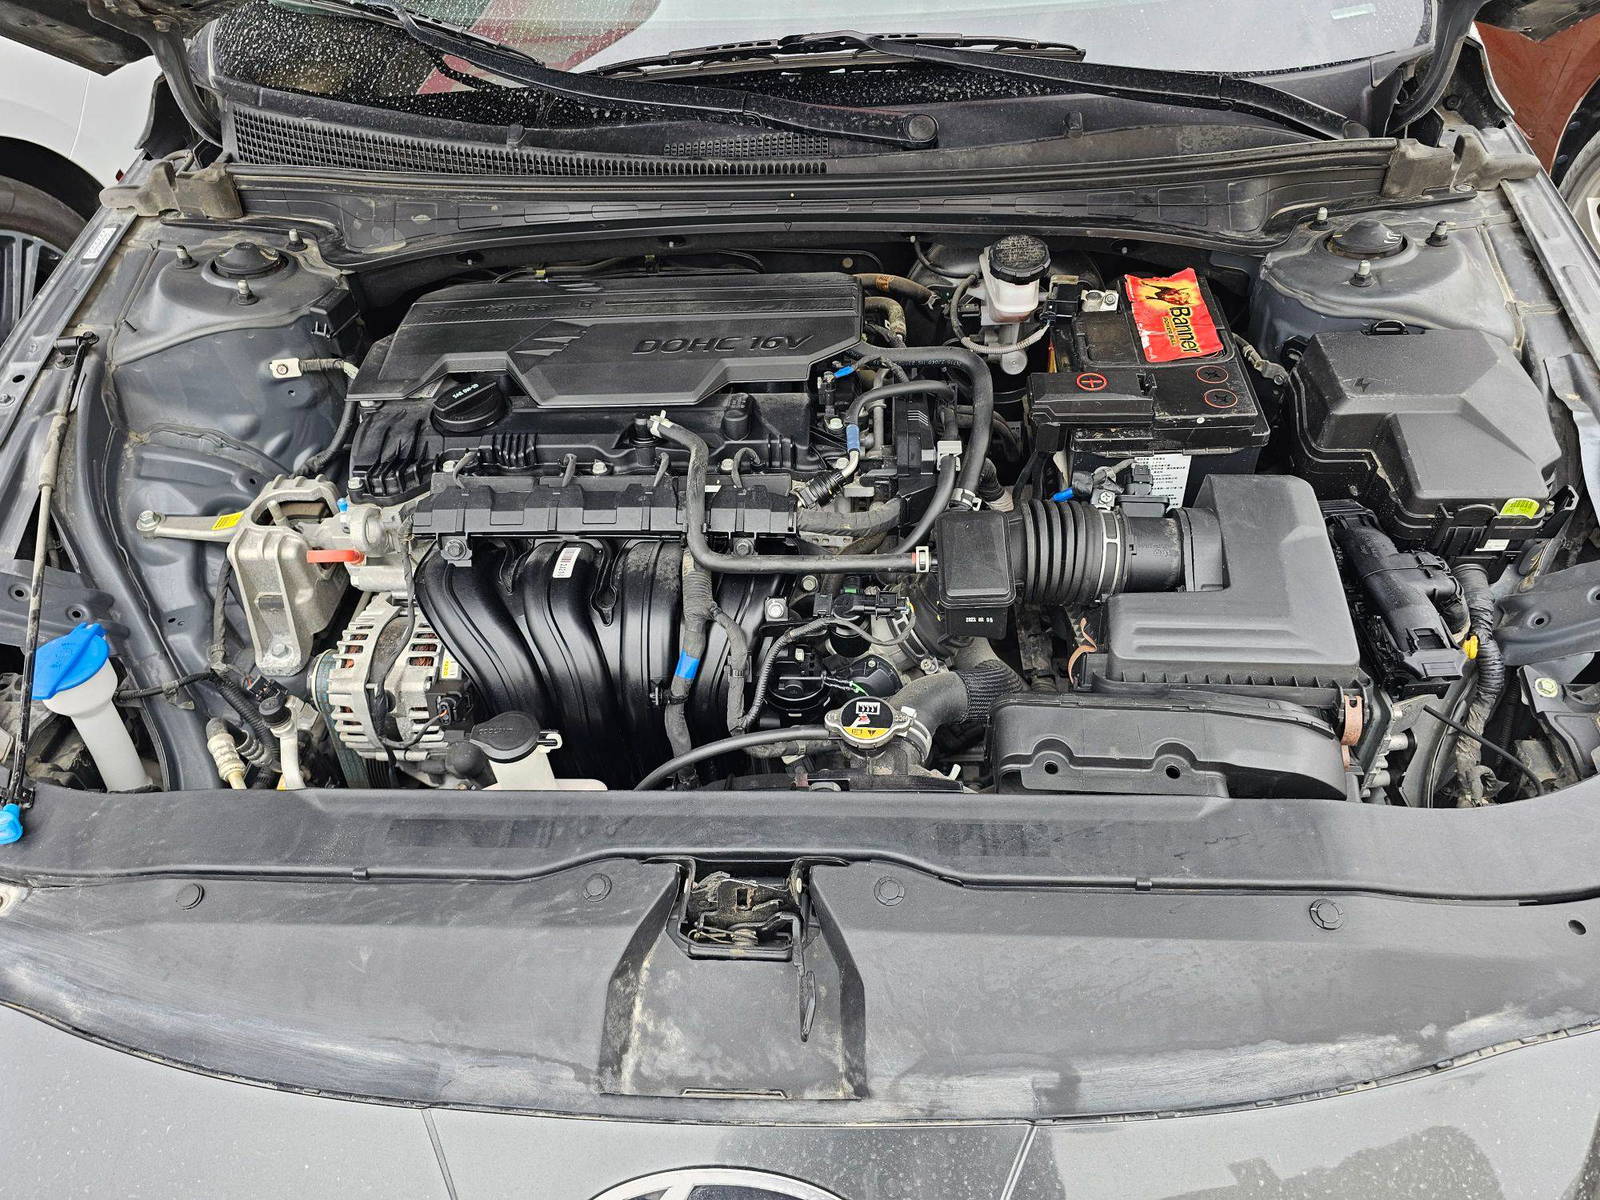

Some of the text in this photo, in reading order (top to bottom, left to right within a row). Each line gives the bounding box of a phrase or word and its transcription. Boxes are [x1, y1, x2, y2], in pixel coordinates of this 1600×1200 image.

[632, 334, 815, 355] DOHC 16V
[1169, 306, 1201, 353] Banner
